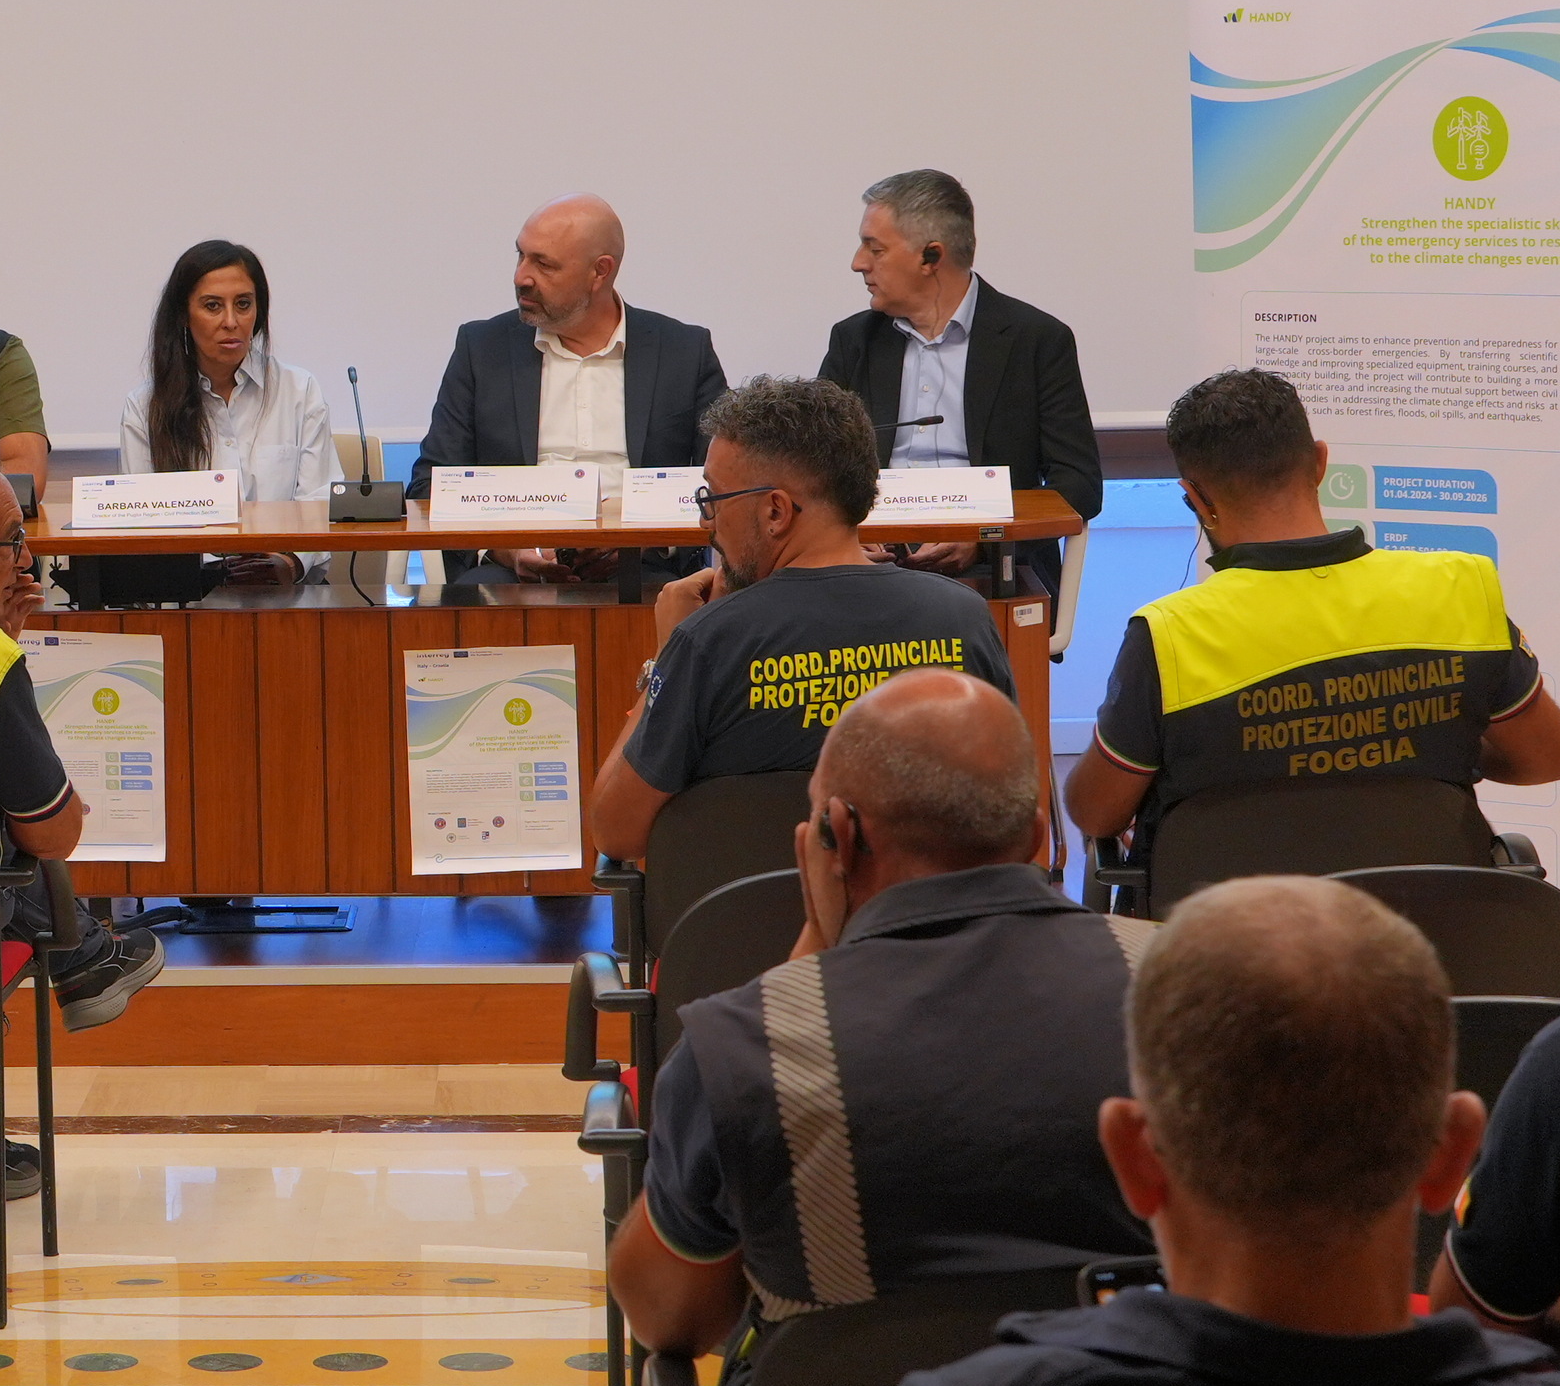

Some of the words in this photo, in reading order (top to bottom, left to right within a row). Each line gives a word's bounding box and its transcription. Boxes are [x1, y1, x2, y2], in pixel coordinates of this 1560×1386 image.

[1249, 12, 1291, 23] HANDY
[1444, 197, 1496, 210] HANDY
[1361, 217, 1437, 231] Strengthen
[1441, 217, 1463, 229] the
[1467, 218, 1541, 233] specialistic
[1343, 234, 1357, 246] of
[1360, 234, 1383, 246] the
[1387, 236, 1461, 250] emergency
[1464, 236, 1518, 247] services
[1522, 237, 1536, 247] to
[1370, 253, 1384, 264] to
[1387, 252, 1410, 264] the
[1414, 252, 1464, 264] climate
[1468, 253, 1522, 268] changes
[1254, 313, 1317, 323] DESCRIPTION
[1255, 334, 1270, 343] The
[1273, 334, 1303, 344] HANDY
[1306, 335, 1335, 346] project
[1338, 335, 1359, 344] aims
[1373, 336, 1411, 346] enhance
[1413, 337, 1461, 347] prevention
[1463, 338, 1480, 347] and
[1482, 339, 1542, 349] preparedness
[1544, 340, 1558, 349] for
[1255, 346, 1299, 356] large-scale
[1308, 347, 1362, 356] cross-border
[1372, 349, 1430, 359] emergencies.
[1439, 349, 1451, 360] By
[1460, 350, 1511, 362] transferring
[1519, 351, 1558, 361] scientific
[1255, 357, 1300, 368] knowledge
[1301, 358, 1318, 367] and
[1320, 359, 1364, 370] improving
[1366, 360, 1414, 370] specialized
[1415, 362, 1466, 373] equipment,
[1467, 363, 1501, 374] training
[1502, 365, 1539, 374] courses,
[1541, 365, 1558, 374] and
[1383, 477, 1423, 487] PROJECT
[1425, 478, 1475, 490] DURATION
[461, 495, 490, 503] MATO
[493, 493, 568, 503] TOMLJANOVIĆ
[883, 495, 938, 504] GABRIELE
[941, 494, 968, 502] PIZZI
[1383, 489, 1432, 500] 01.04.2024
[1439, 491, 1488, 503] 30.09.2026
[97, 501, 148, 511] BARBARA
[151, 499, 214, 509] VALENZANO
[1384, 532, 1408, 543] ERDF
[1237, 682, 1319, 718] COORD.
[1324, 655, 1466, 706] PROVINCIALE
[1242, 706, 1386, 751] PROTEZIONE
[1392, 692, 1463, 730] CIVILE
[1288, 736, 1416, 776] FOGGIA
